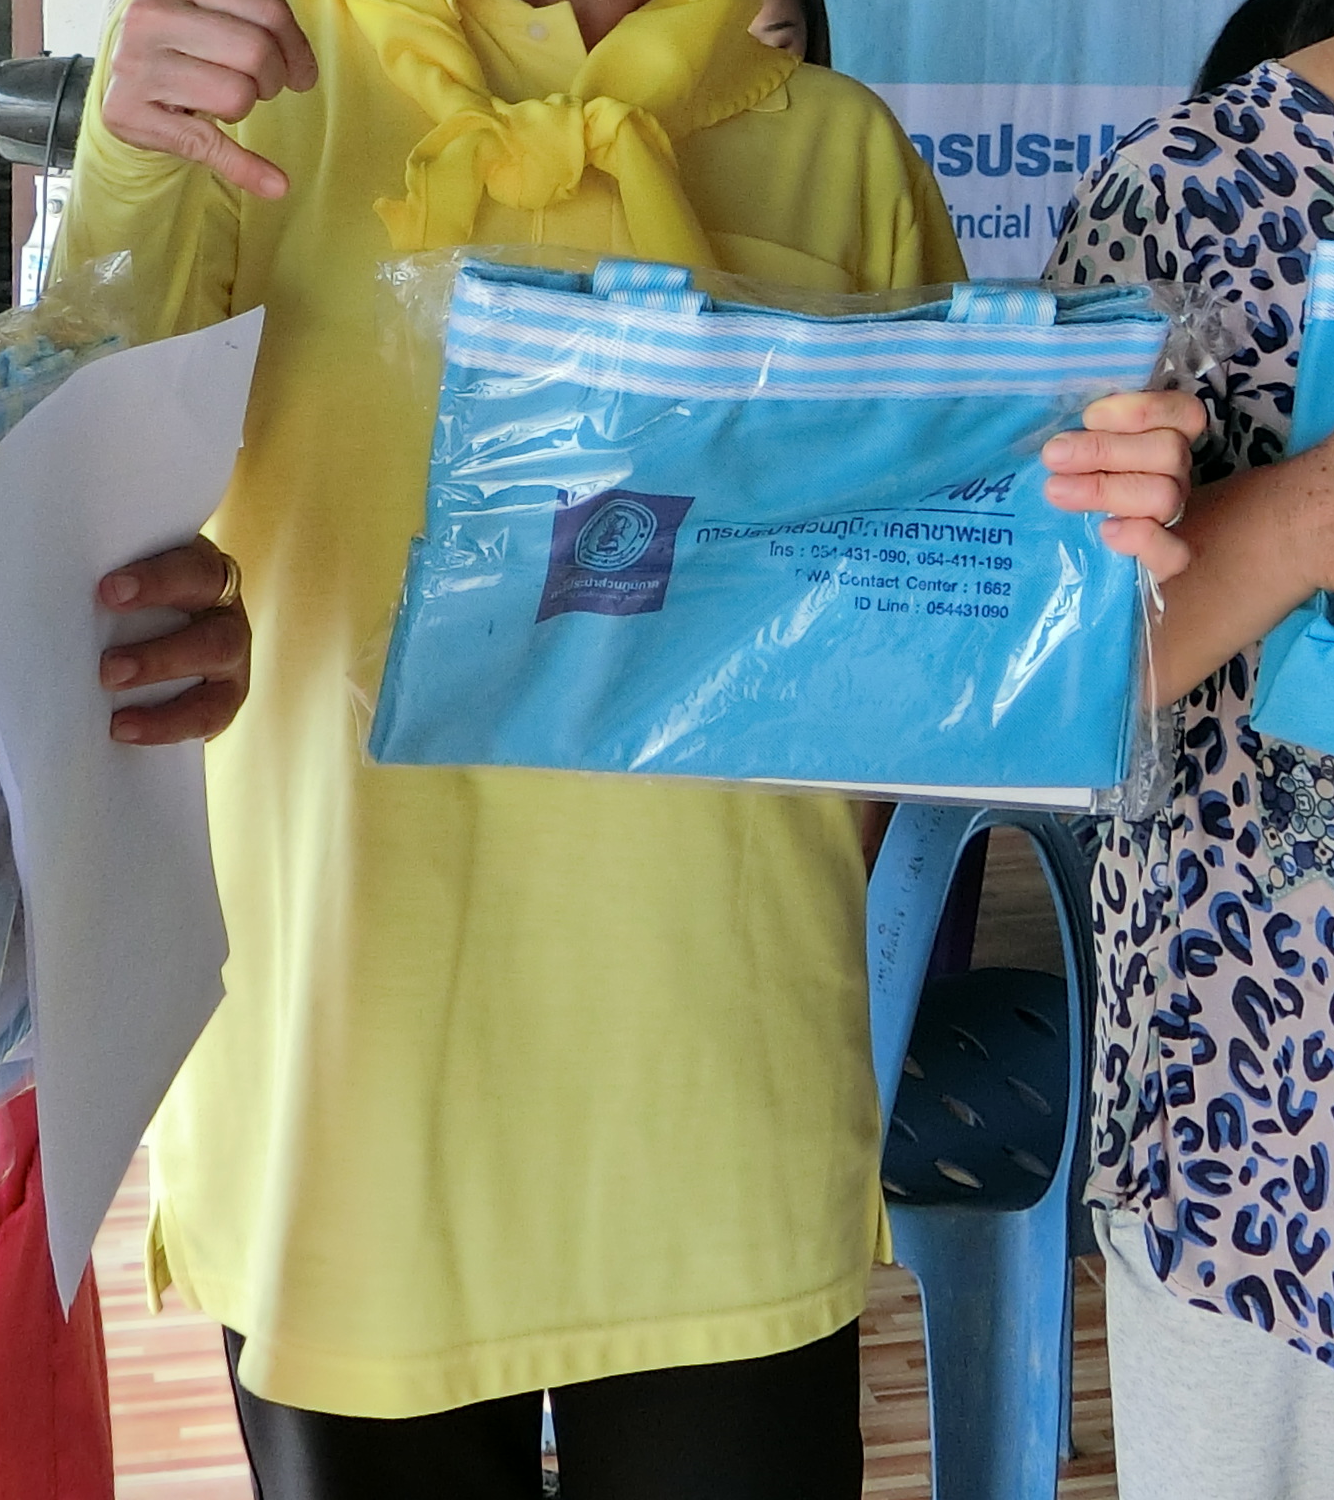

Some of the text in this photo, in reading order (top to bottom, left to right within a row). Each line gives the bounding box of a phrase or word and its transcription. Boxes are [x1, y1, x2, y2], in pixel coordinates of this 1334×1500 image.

[917, 553, 1013, 570] 054-411-199
[839, 572, 899, 589] Contact
[906, 576, 958, 593] Center
[975, 581, 1011, 596] 1662
[854, 597, 871, 610] ID
[877, 598, 909, 613] Line
[926, 601, 1009, 618] 054431090
